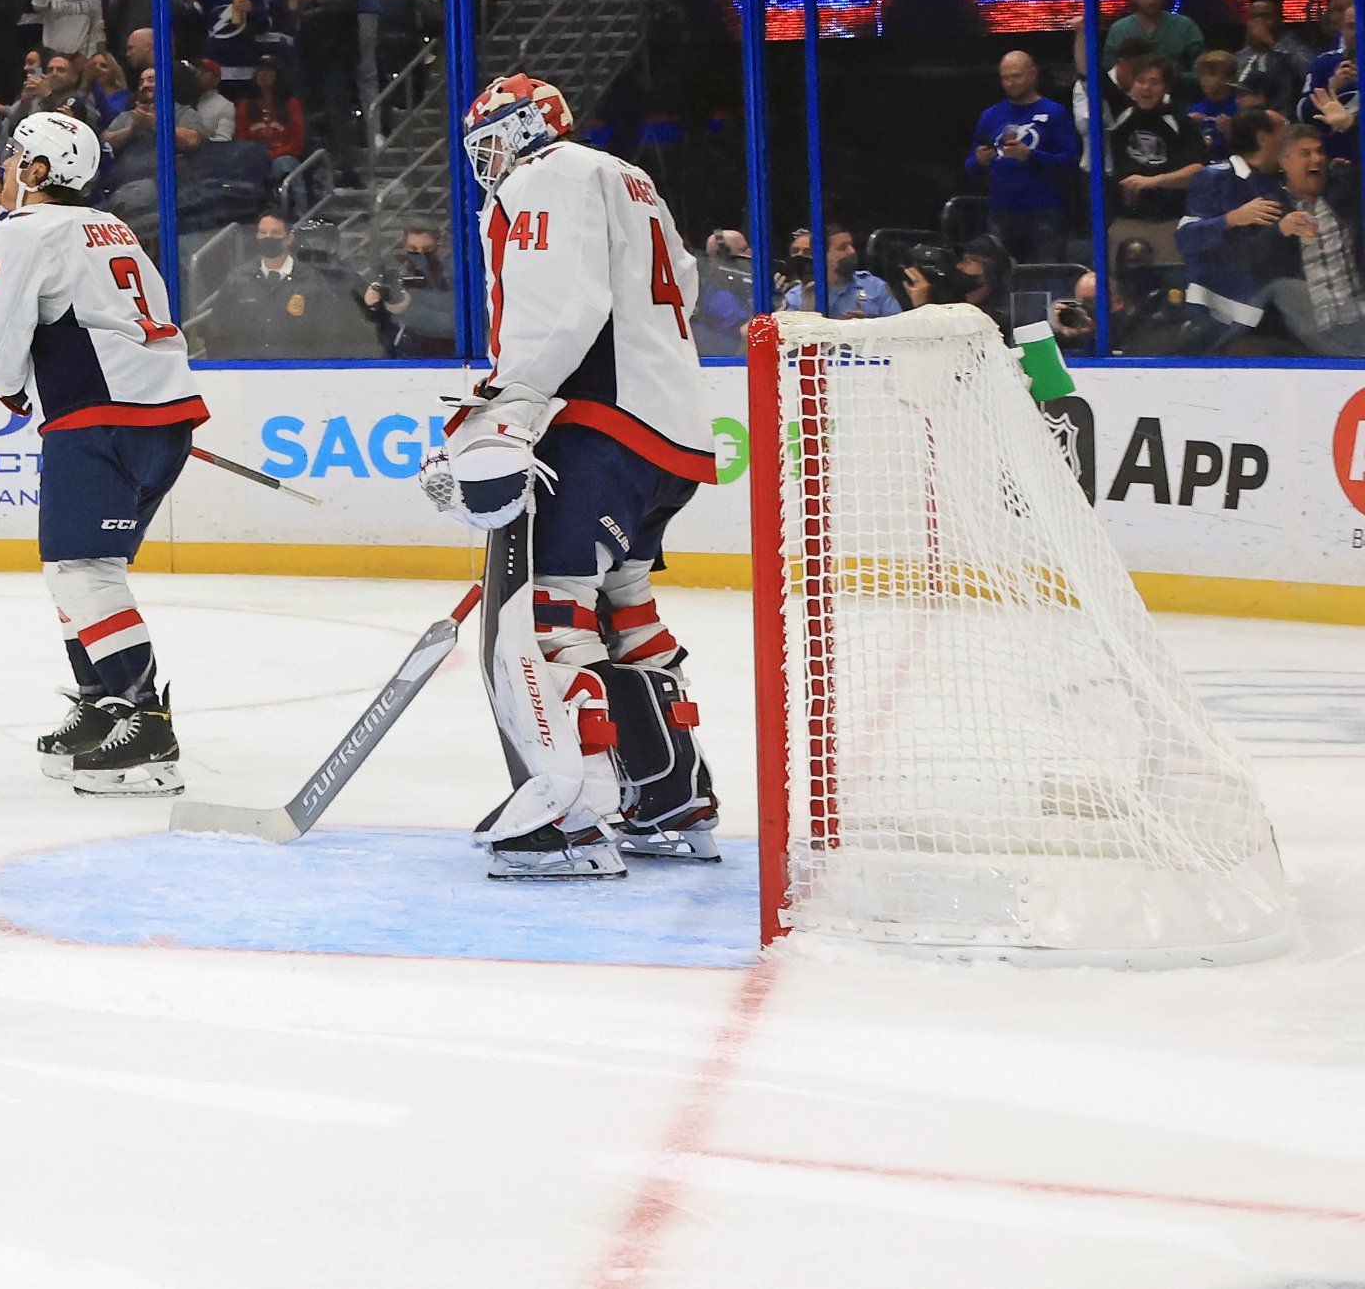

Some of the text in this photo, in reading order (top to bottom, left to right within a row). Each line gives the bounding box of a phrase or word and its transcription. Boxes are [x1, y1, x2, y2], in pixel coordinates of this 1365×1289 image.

[509, 211, 550, 251] 41
[650, 216, 689, 340] 4
[301, 685, 401, 817] SUPREME
[519, 655, 556, 752] SUPREME
